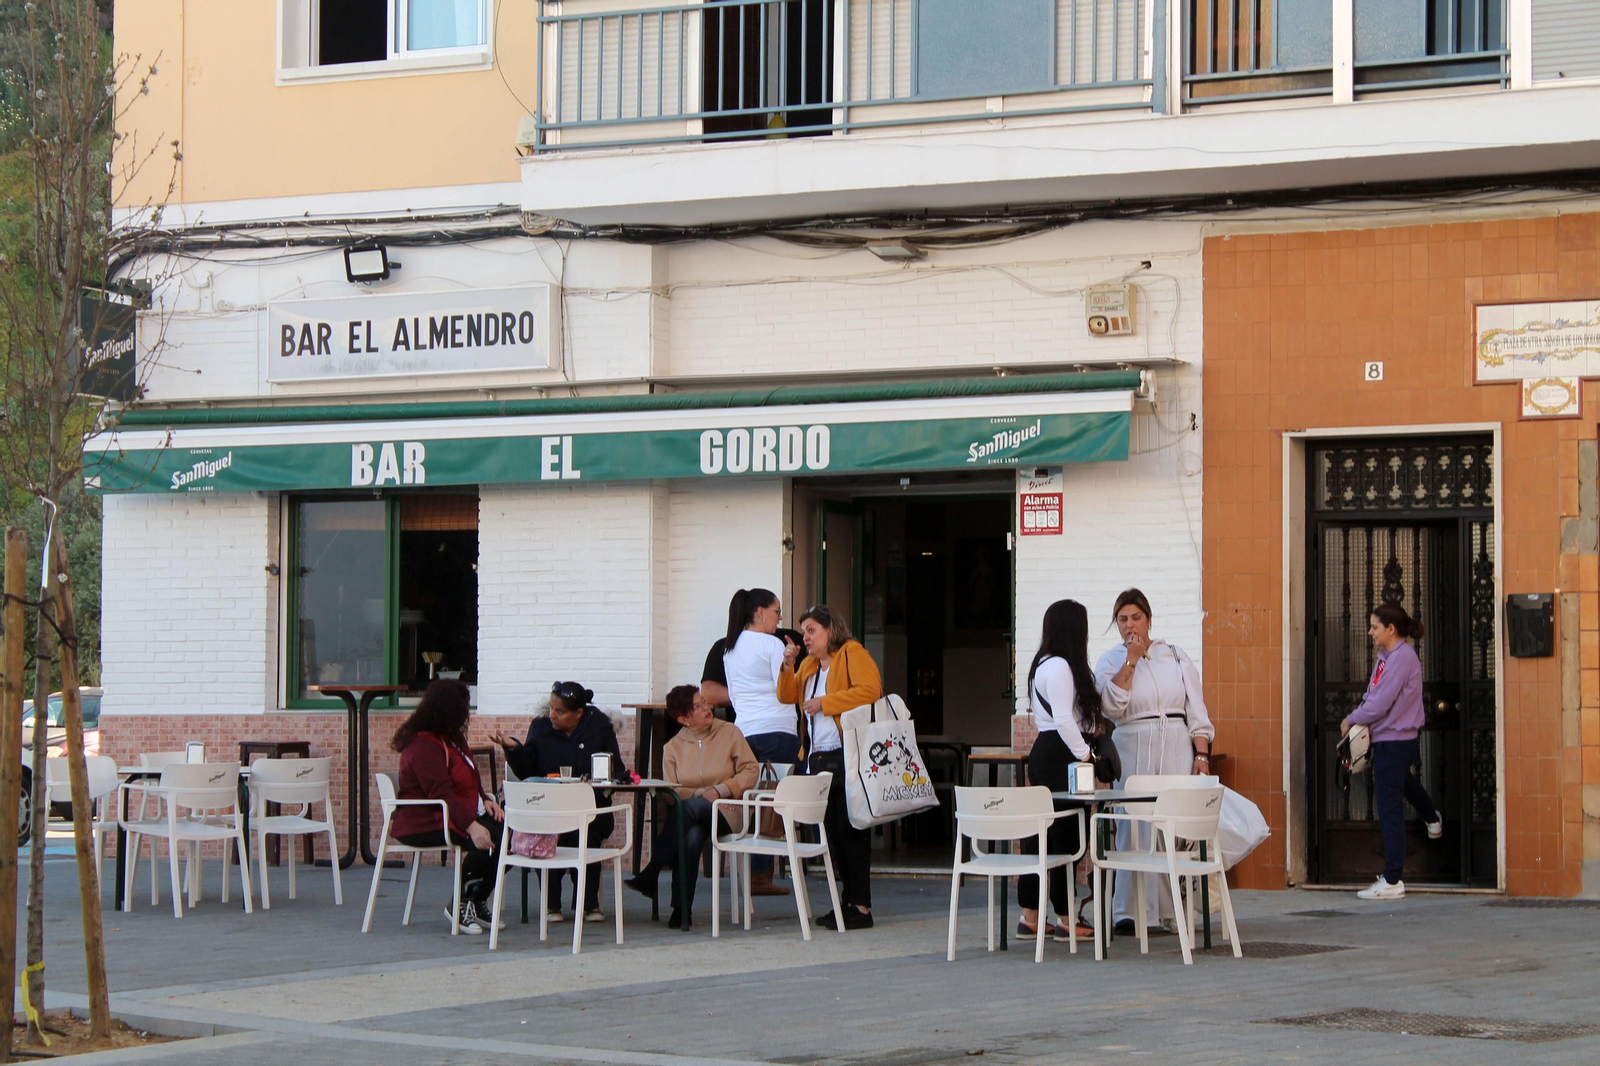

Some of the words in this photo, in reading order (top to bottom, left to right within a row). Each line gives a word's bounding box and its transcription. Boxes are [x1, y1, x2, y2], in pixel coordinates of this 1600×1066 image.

[281, 323, 332, 357] BAR
[349, 320, 379, 354] EL
[391, 310, 534, 351] ALMENDRO
[1503, 337, 1519, 349] PLAZA
[1520, 336, 1527, 348] DE
[1565, 334, 1572, 346] DE
[1573, 334, 1583, 345] LOS
[1368, 363, 1380, 379] 8
[351, 442, 425, 486] BAR
[540, 436, 581, 480] EL
[700, 424, 831, 475] GORDO
[1029, 477, 1055, 490] Direct
[1024, 494, 1060, 505] Alarma
[883, 781, 933, 801] MICKEY
